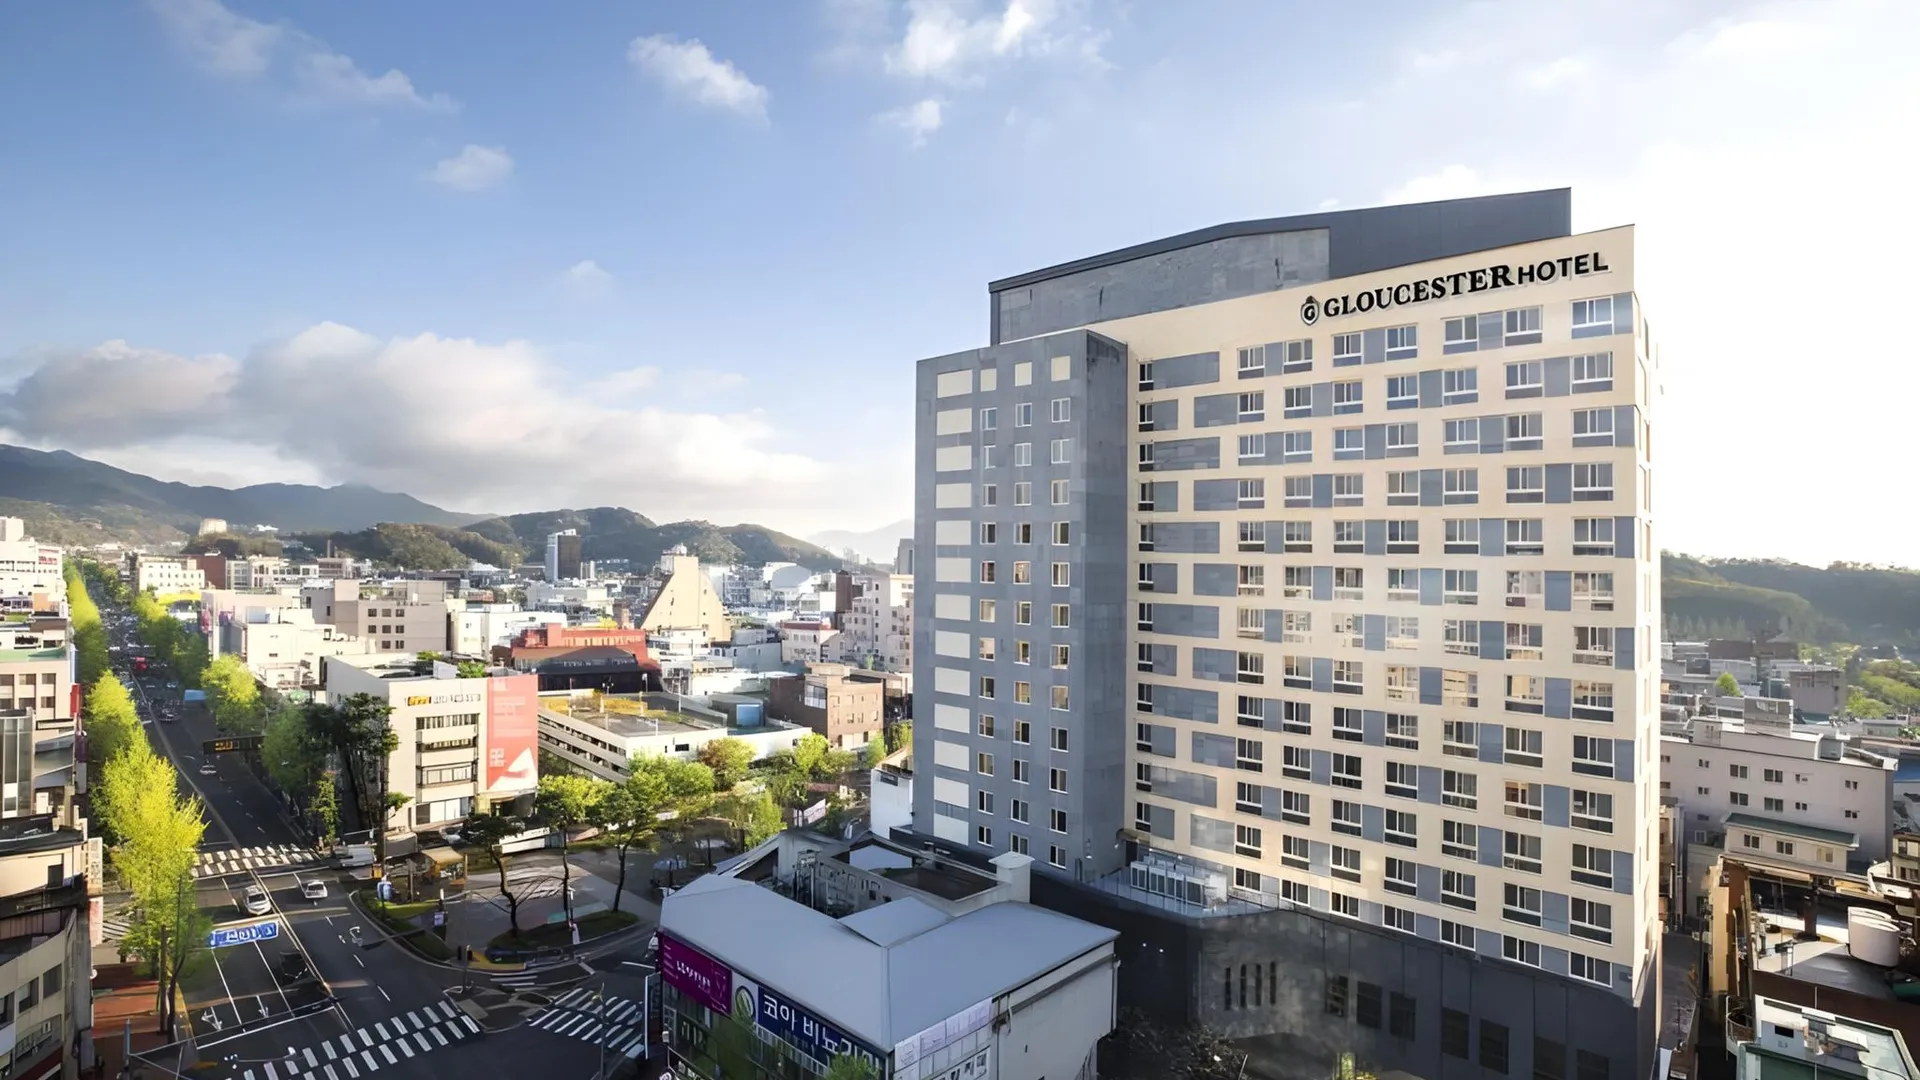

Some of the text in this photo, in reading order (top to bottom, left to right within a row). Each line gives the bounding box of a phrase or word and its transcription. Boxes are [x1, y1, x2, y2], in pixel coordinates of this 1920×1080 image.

[1323, 265, 1515, 318] GLOUCESTER
[1517, 252, 1609, 286] HOTEL
[763, 994, 797, 1031] 코아
